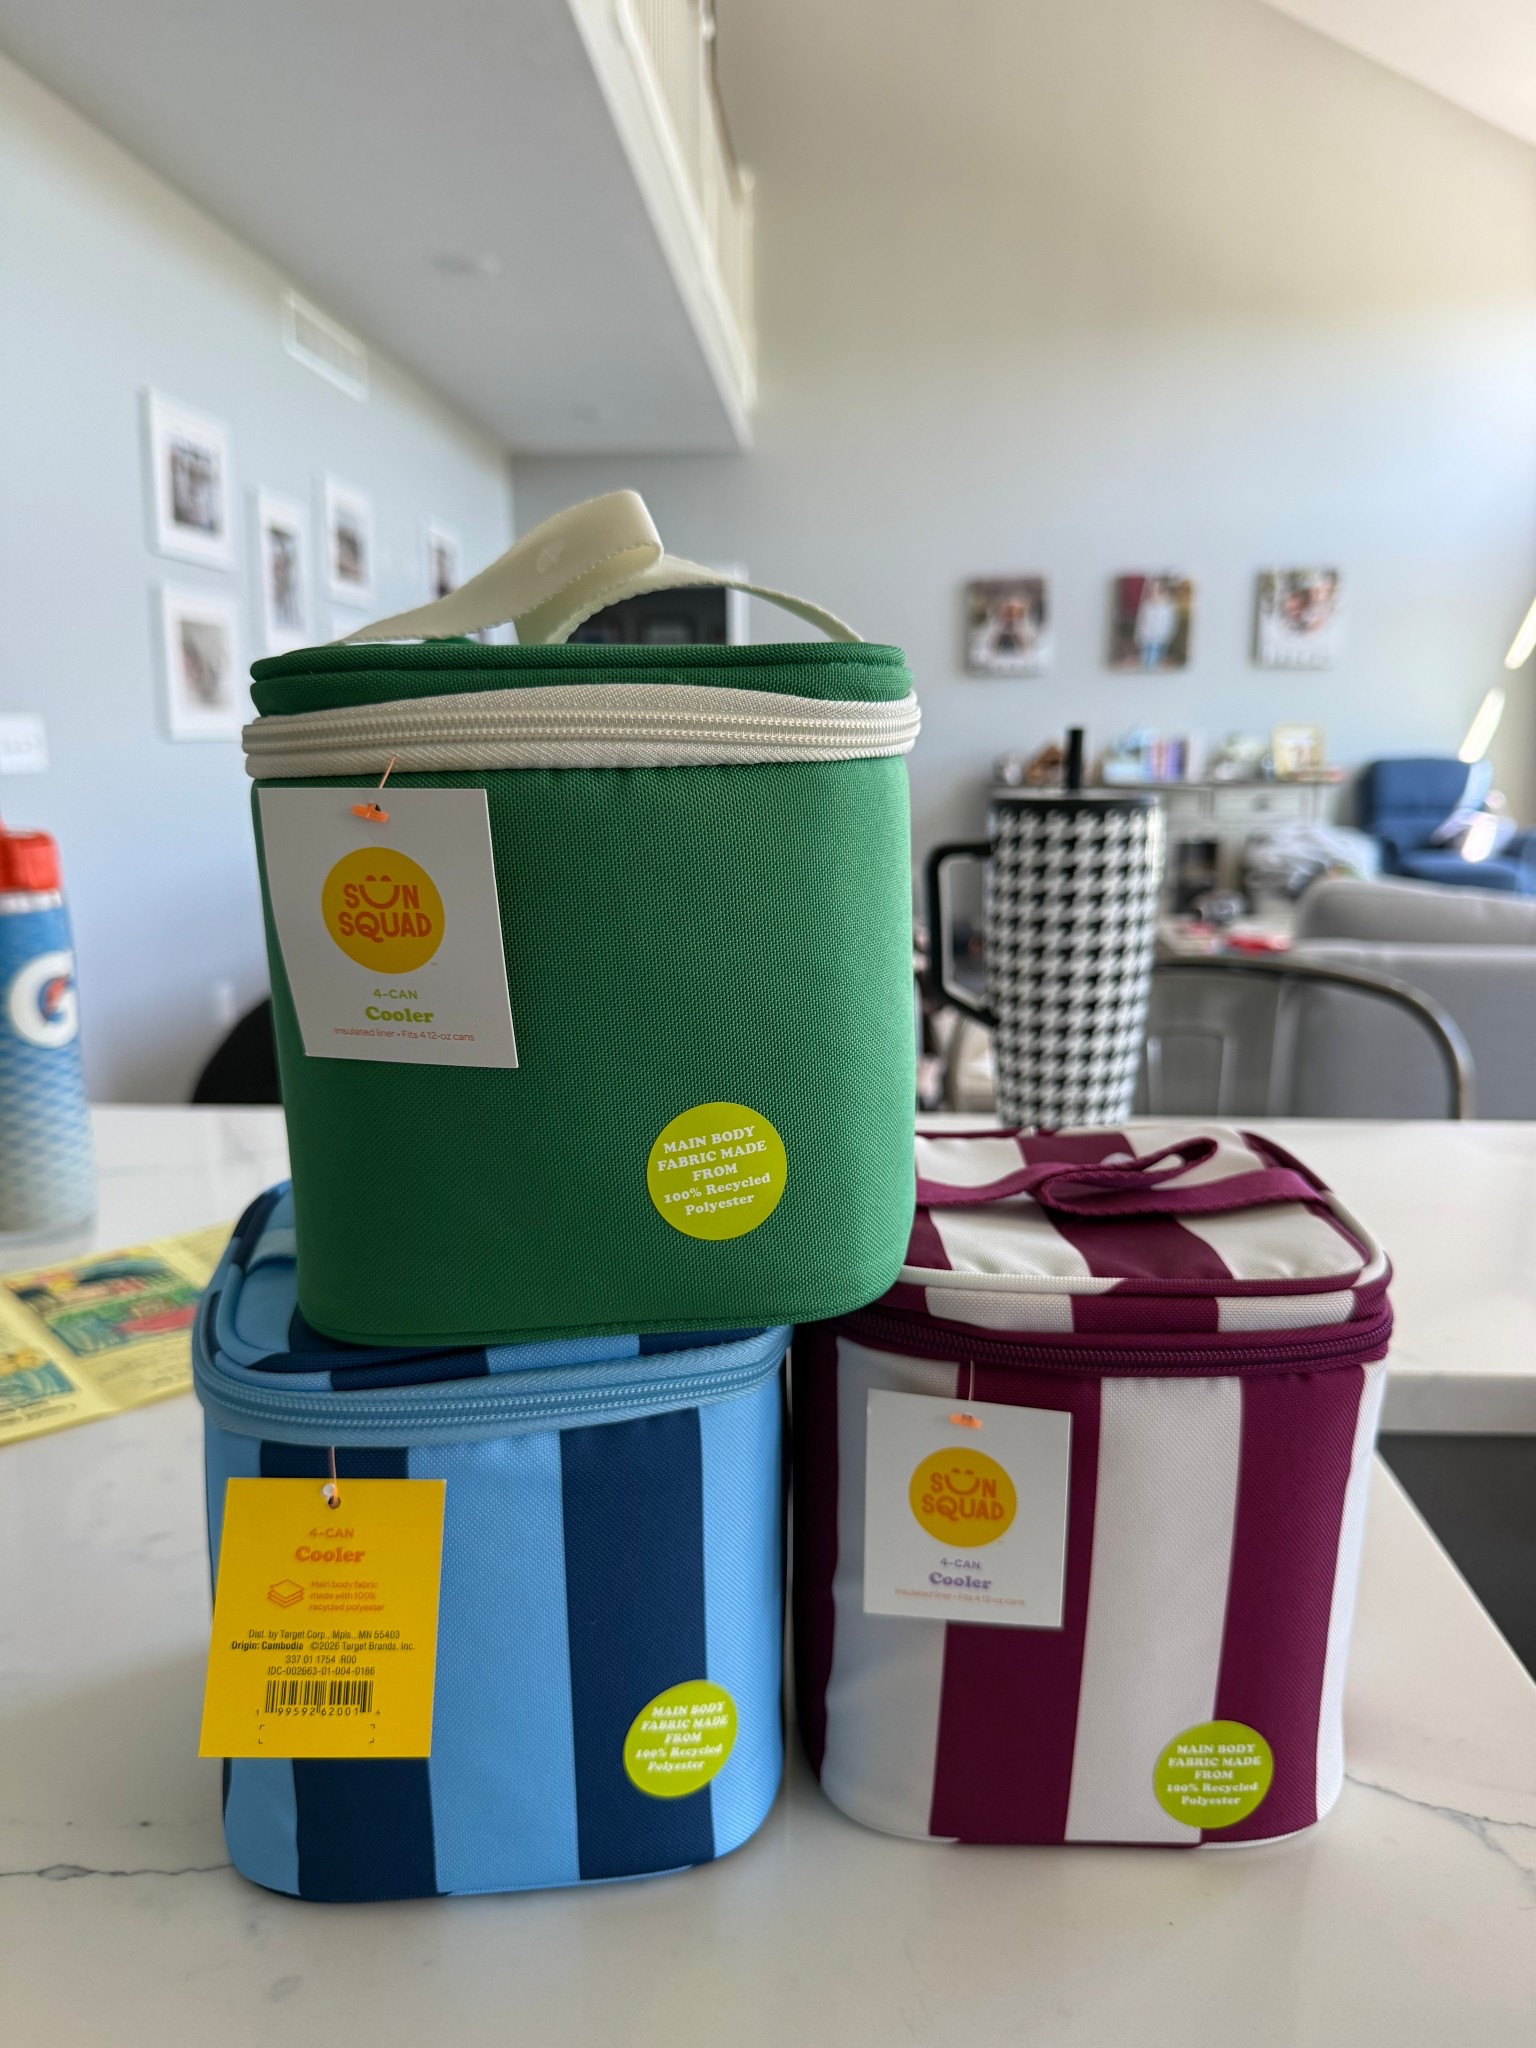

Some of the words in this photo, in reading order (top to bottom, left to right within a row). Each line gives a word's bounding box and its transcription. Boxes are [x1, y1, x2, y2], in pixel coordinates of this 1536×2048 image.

[344, 883, 420, 910] SUN
[338, 911, 432, 943] SQUAD
[373, 988, 418, 1000] 4-CAN
[365, 1006, 434, 1023] Cooler
[334, 1027, 375, 1037] Insulated
[376, 1028, 395, 1038] liner
[402, 1030, 419, 1039] Fits
[420, 1031, 426, 1039] 4
[427, 1031, 451, 1040] 12-oz
[453, 1033, 476, 1042] cans
[663, 1136, 707, 1154] MAIN
[711, 1125, 756, 1145] BODY
[657, 1151, 717, 1172] FABRIC
[720, 1140, 767, 1160] MADE
[692, 1163, 738, 1182] FROM
[664, 1187, 702, 1204] 100%
[706, 1172, 771, 1196] Recycled
[685, 1194, 755, 1216] Polyester
[930, 1472, 997, 1498] SUN
[922, 1494, 1004, 1521] SQUAD
[309, 1528, 354, 1538] 4-CAN
[295, 1546, 366, 1562] Cooler
[940, 1558, 981, 1569] 4-CAN
[311, 1580, 330, 1588] Main
[332, 1580, 353, 1589] body
[354, 1580, 378, 1588] fabric
[929, 1571, 992, 1589] Cooler
[310, 1591, 334, 1599] made
[335, 1591, 353, 1599] with
[355, 1591, 376, 1599] 100%
[310, 1603, 345, 1612] recycled
[346, 1603, 385, 1612] polyester
[249, 1629, 265, 1638] Dist.
[268, 1629, 279, 1640] by
[281, 1629, 305, 1640] Target
[358, 1630, 373, 1639] MN
[374, 1629, 400, 1639] 55403
[231, 1641, 260, 1652] Origin:
[261, 1641, 304, 1650] Cambodia
[342, 1641, 368, 1652] Target
[401, 1641, 416, 1651] Inc.
[285, 1655, 301, 1664] 337
[303, 1655, 313, 1664] 01
[316, 1655, 336, 1664] 1754
[340, 1655, 357, 1664] R00
[651, 1705, 689, 1717] MAIN
[690, 1701, 726, 1715] BODY
[641, 1719, 691, 1732] FABRIC
[693, 1715, 729, 1729] MADE
[664, 1731, 702, 1745] FROM
[635, 1747, 668, 1760] 100%
[670, 1743, 723, 1759] Recycled
[1177, 1744, 1213, 1754] MAIN
[1218, 1744, 1256, 1753] BODY
[647, 1761, 705, 1774] Polyester
[1168, 1757, 1219, 1767] FABRIC
[1222, 1756, 1262, 1766] MADE
[1194, 1770, 1233, 1780] FROM
[1167, 1783, 1198, 1792] 100%
[1202, 1782, 1259, 1794] Recycled
[1181, 1795, 1241, 1806] Polyester
